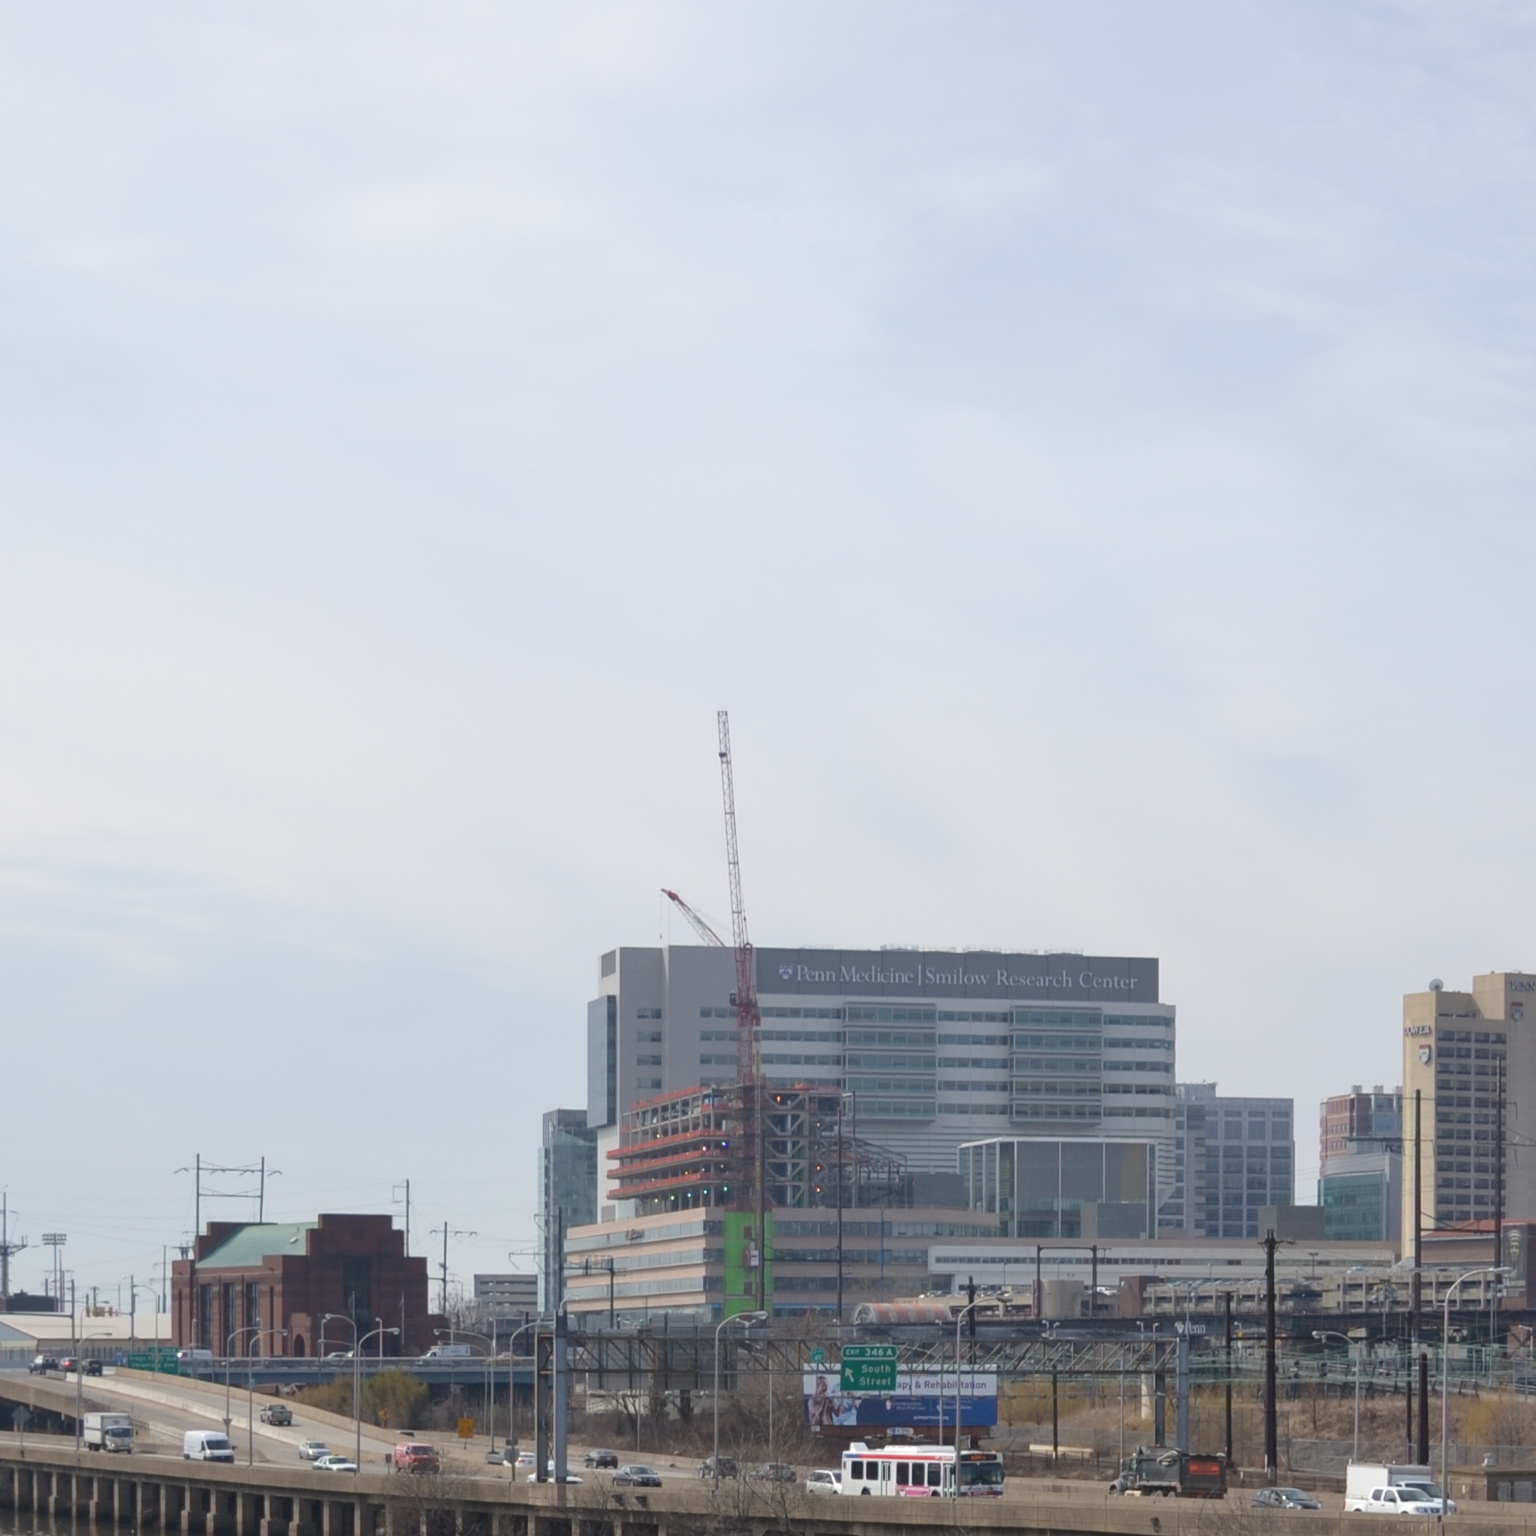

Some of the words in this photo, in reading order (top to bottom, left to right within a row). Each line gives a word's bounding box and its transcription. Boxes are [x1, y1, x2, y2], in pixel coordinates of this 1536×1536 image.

[797, 964, 836, 982] Penn
[839, 965, 914, 984] Medicine
[925, 967, 990, 986] Smilow
[996, 969, 1072, 988] Research
[1079, 971, 1138, 990] Center
[865, 1348, 884, 1356] 346
[886, 1348, 893, 1356] A
[861, 1364, 891, 1373] South
[859, 1377, 891, 1386] Street
[924, 1380, 987, 1389] Rehabiltation
